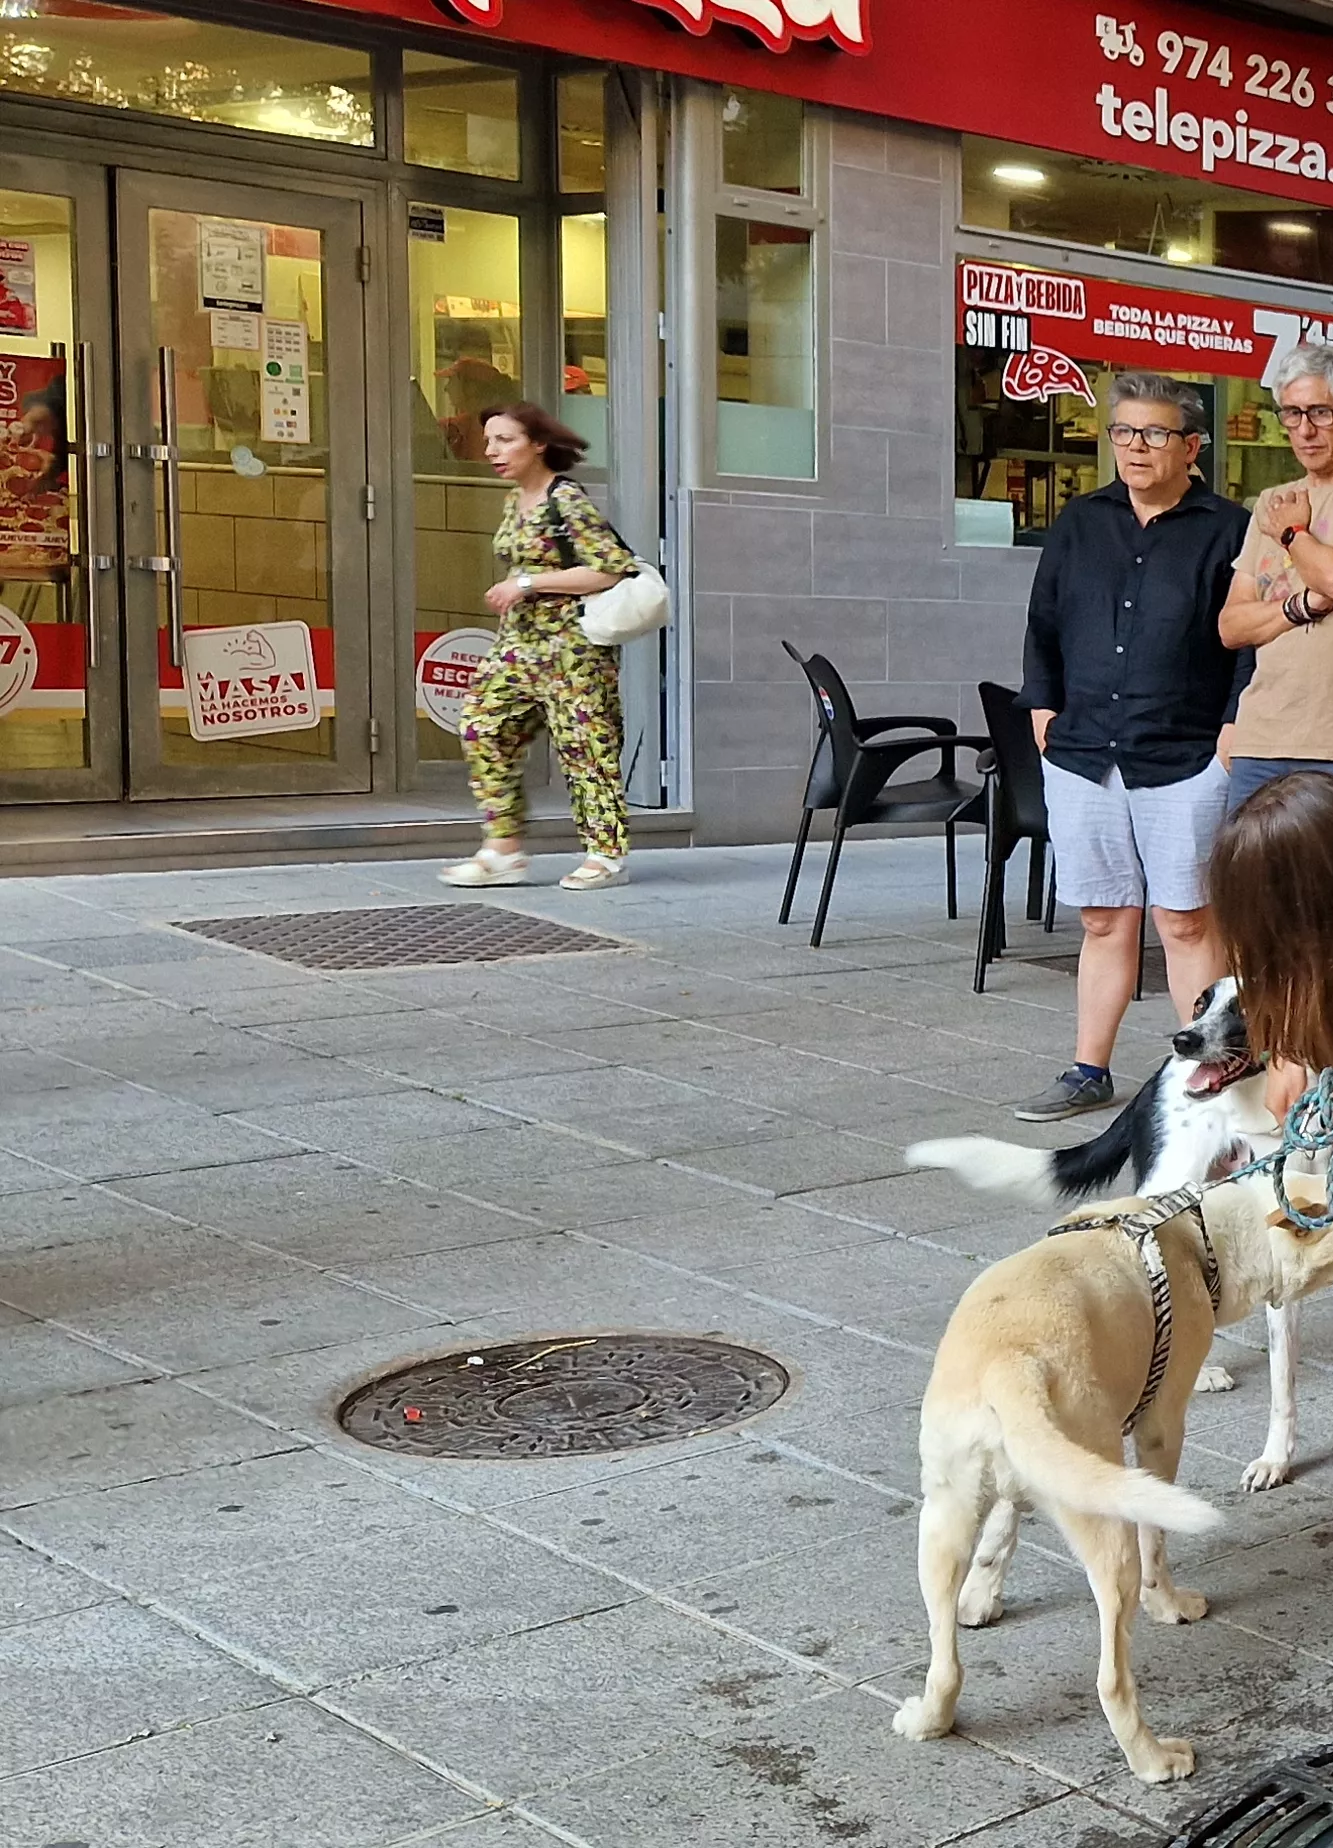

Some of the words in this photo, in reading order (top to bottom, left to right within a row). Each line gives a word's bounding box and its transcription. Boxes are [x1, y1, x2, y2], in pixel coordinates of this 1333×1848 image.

[1156, 30, 1233, 88] 974
[1244, 54, 1315, 108] 226
[966, 269, 1015, 306] PIZZA
[1025, 277, 1083, 316] BEBIDA
[966, 310, 996, 348] SIN
[1002, 315, 1028, 352] FIN
[1109, 303, 1152, 325] TODA
[1155, 310, 1175, 328] LA
[1177, 314, 1221, 334] PIZZA
[1223, 320, 1234, 335] Y
[1093, 319, 1152, 341] BEBIDA
[1154, 328, 1186, 346] QUE
[1188, 332, 1253, 354] QUIERAS
[197, 671, 214, 680] LA
[198, 671, 306, 702] MASA
[201, 703, 217, 713] LA
[221, 695, 288, 710] HACEMOS
[202, 702, 308, 726] NOSOTROS
